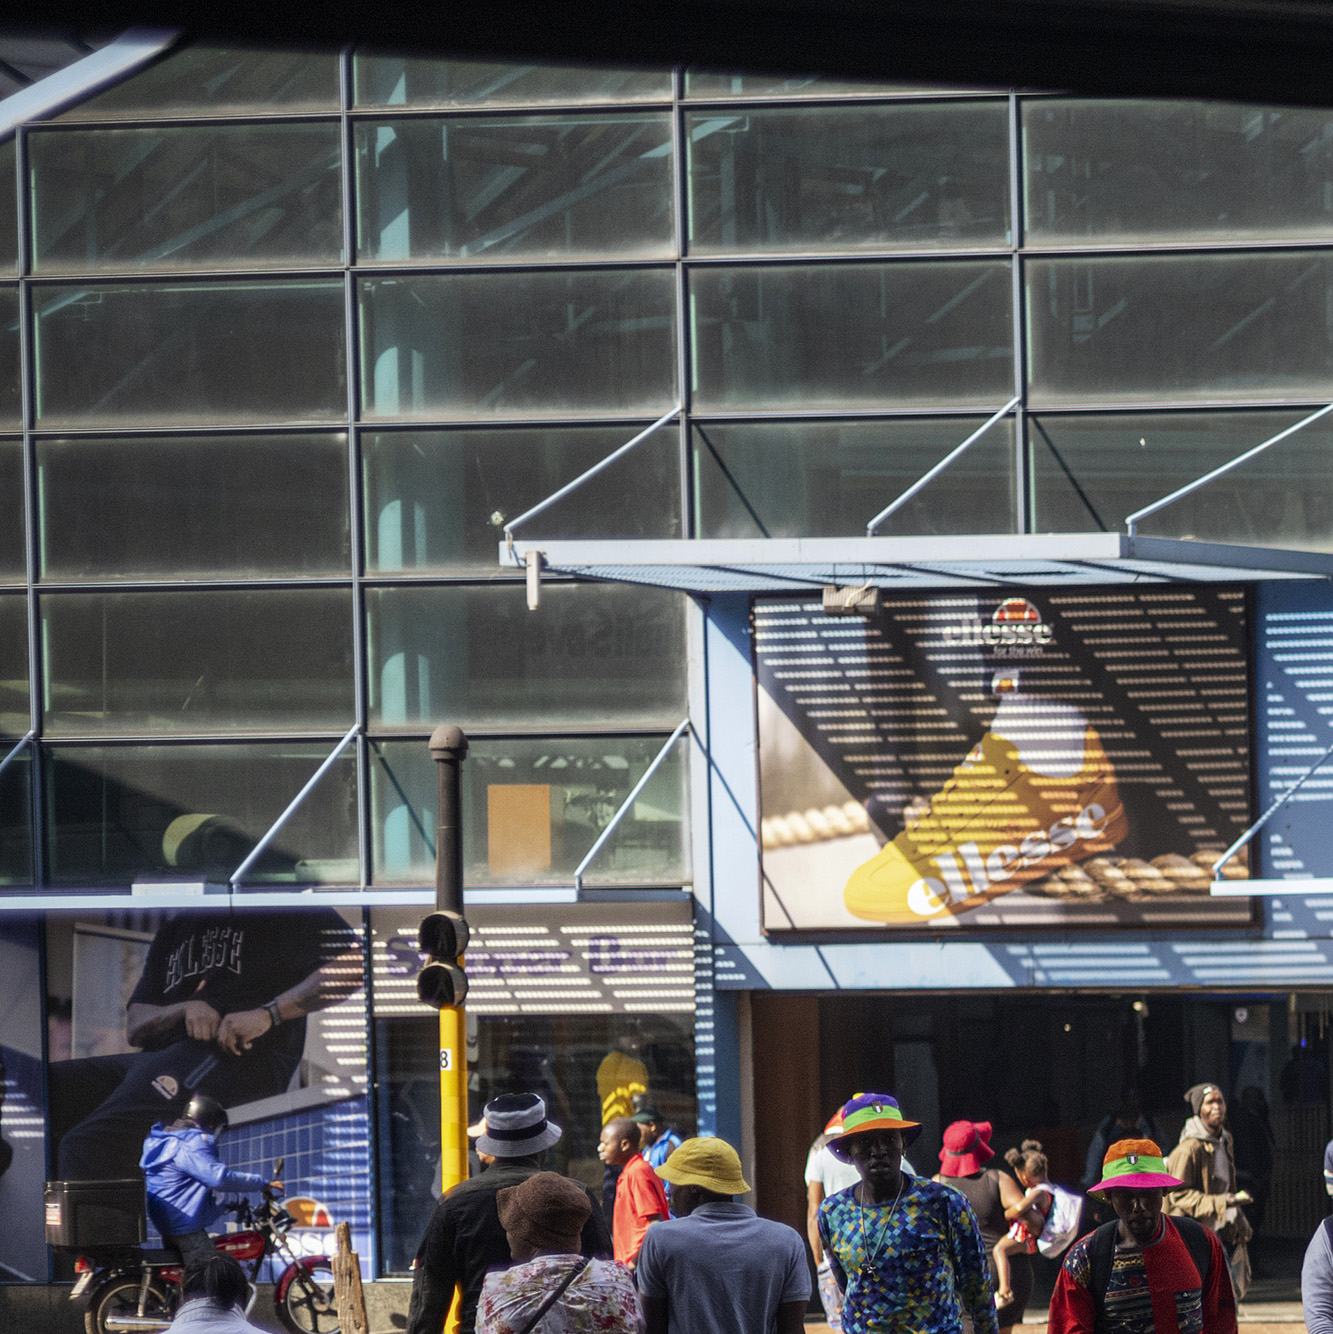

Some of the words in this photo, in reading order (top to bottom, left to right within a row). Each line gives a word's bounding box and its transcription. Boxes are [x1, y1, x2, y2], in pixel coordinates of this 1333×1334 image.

[942, 619, 1053, 645] ellesse
[907, 803, 1108, 916] ellesse
[440, 1051, 449, 1068] 8
